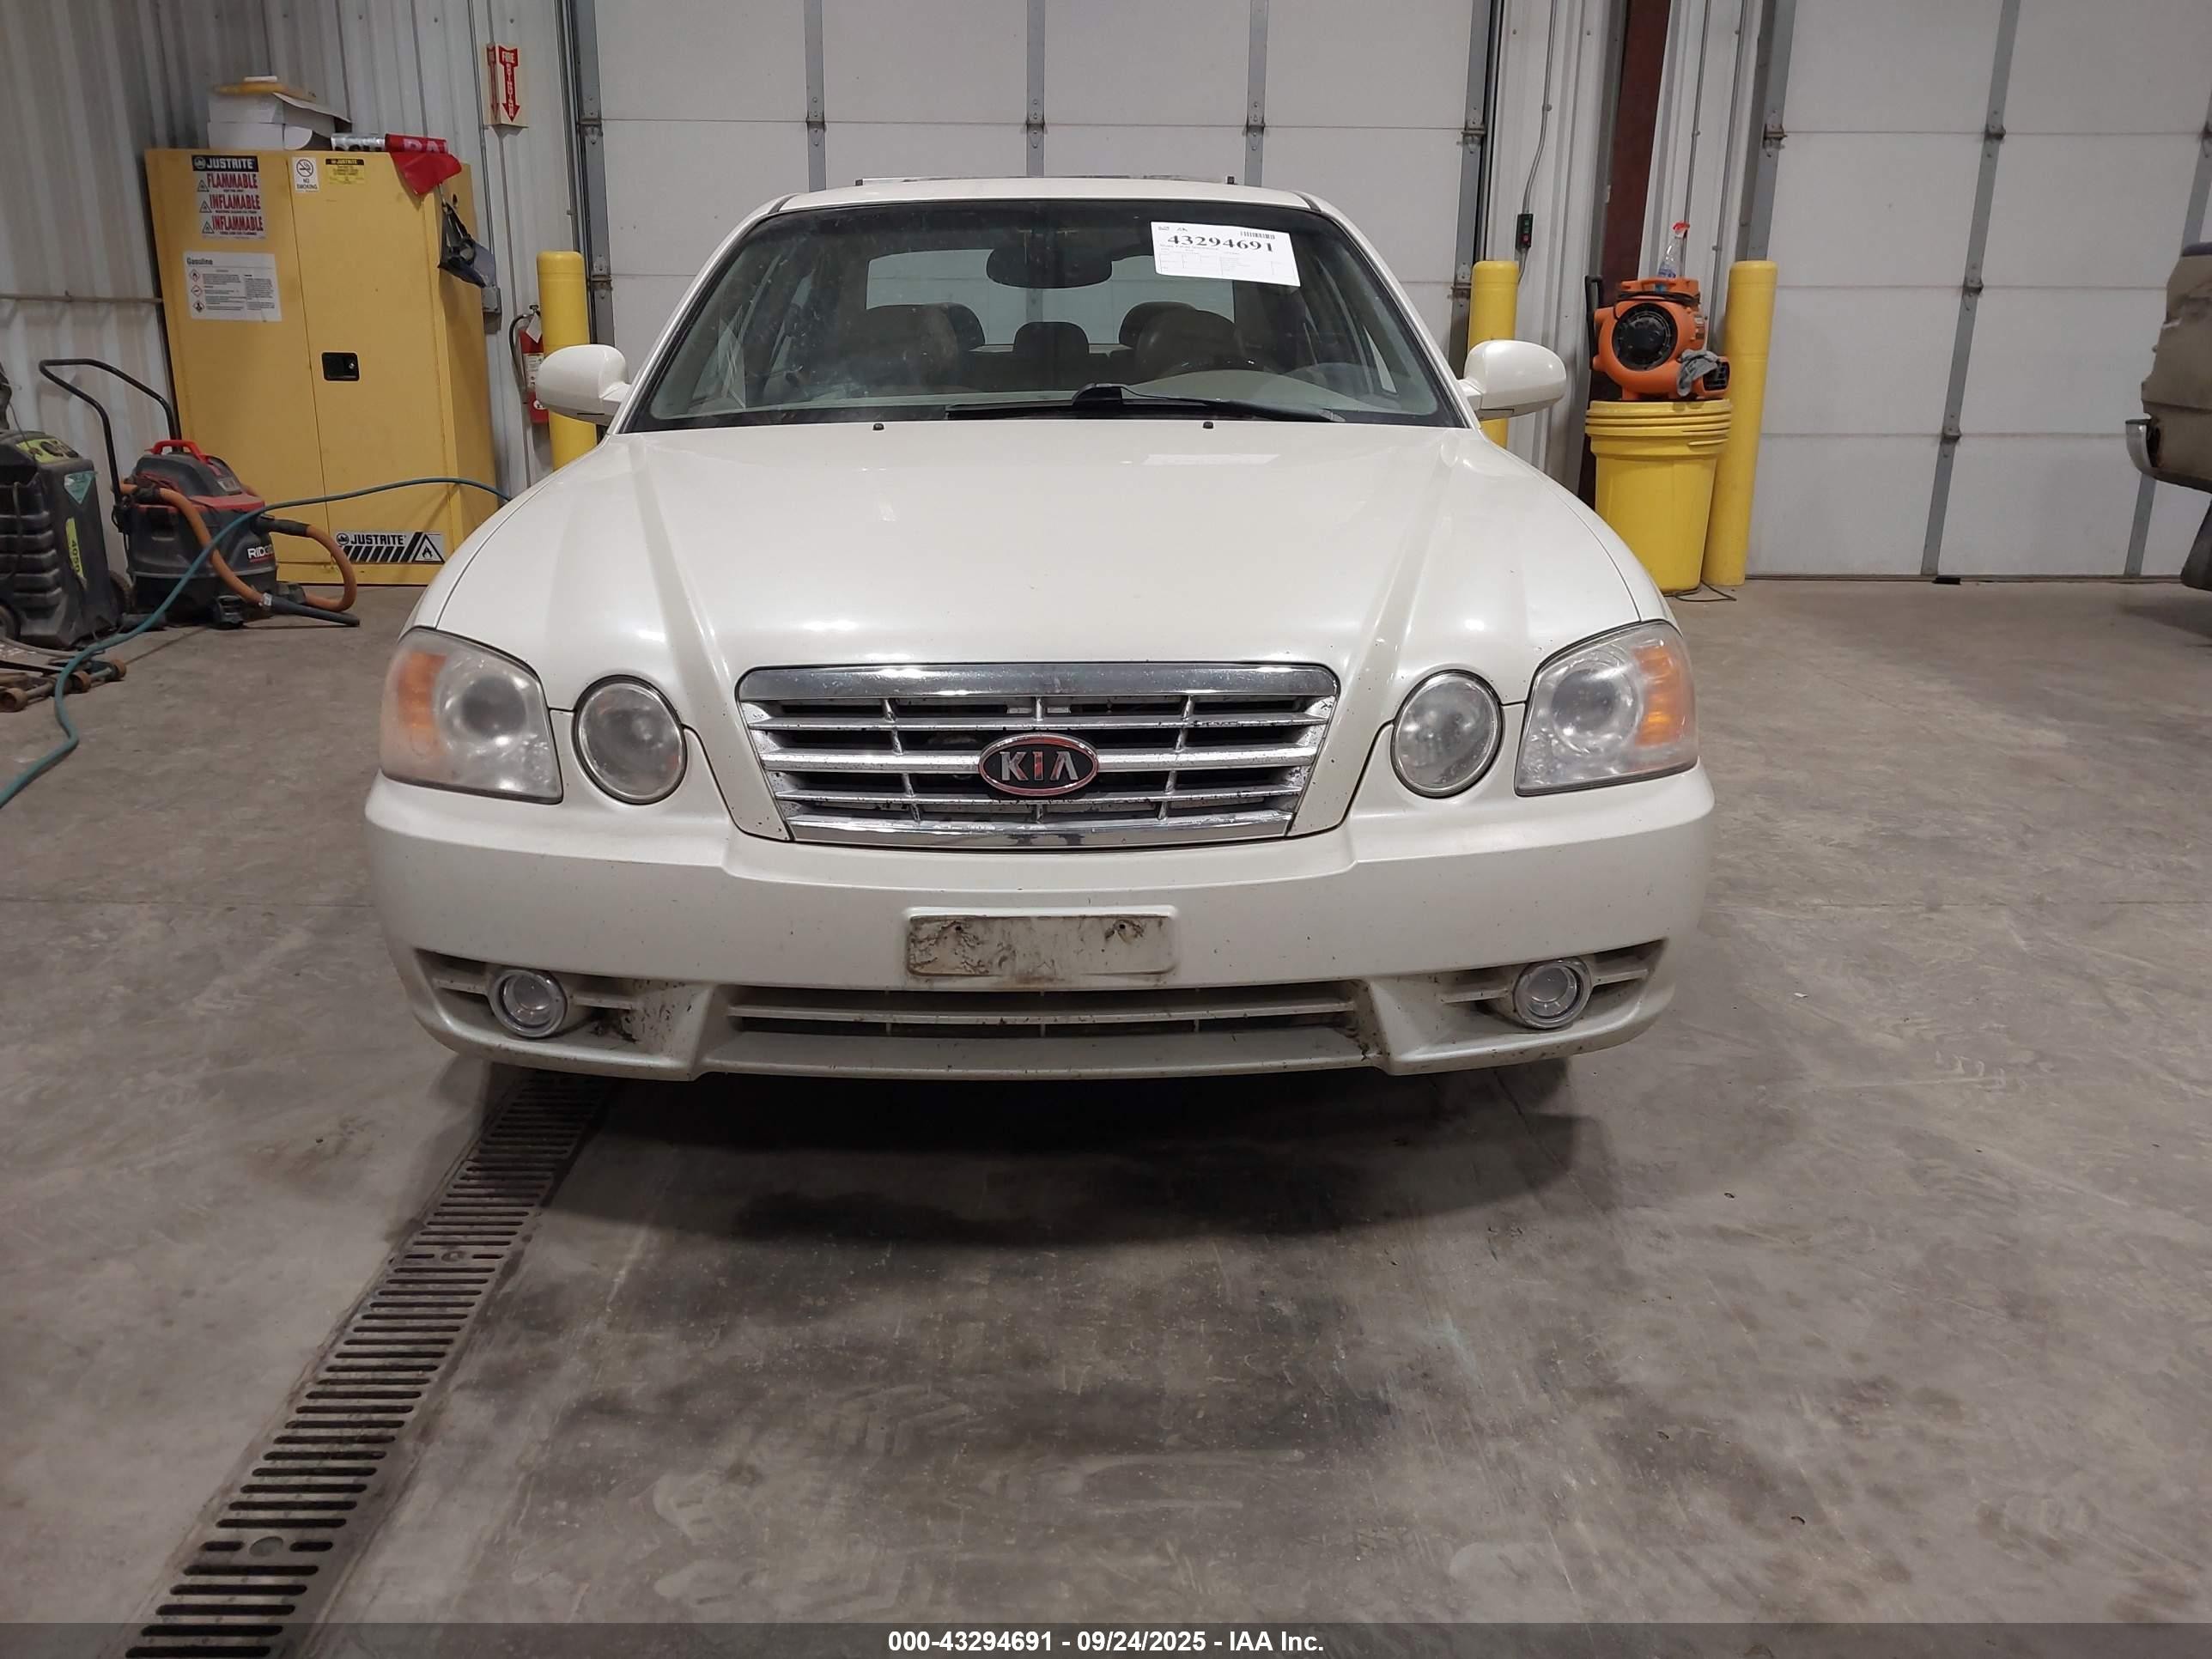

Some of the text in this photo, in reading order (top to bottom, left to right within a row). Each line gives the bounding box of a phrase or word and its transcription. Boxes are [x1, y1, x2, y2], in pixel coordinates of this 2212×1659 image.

[502, 51, 515, 64] FIRE
[207, 158, 254, 170] JUSTRITE
[207, 173, 258, 189] FLAMMABLE
[210, 194, 261, 210] INFLAMABLE
[212, 216, 264, 232] INFLAMMABLE
[1167, 234, 1273, 252] 43294691
[350, 534, 404, 545] JUSTRITE
[1000, 750, 1079, 781] KIA
